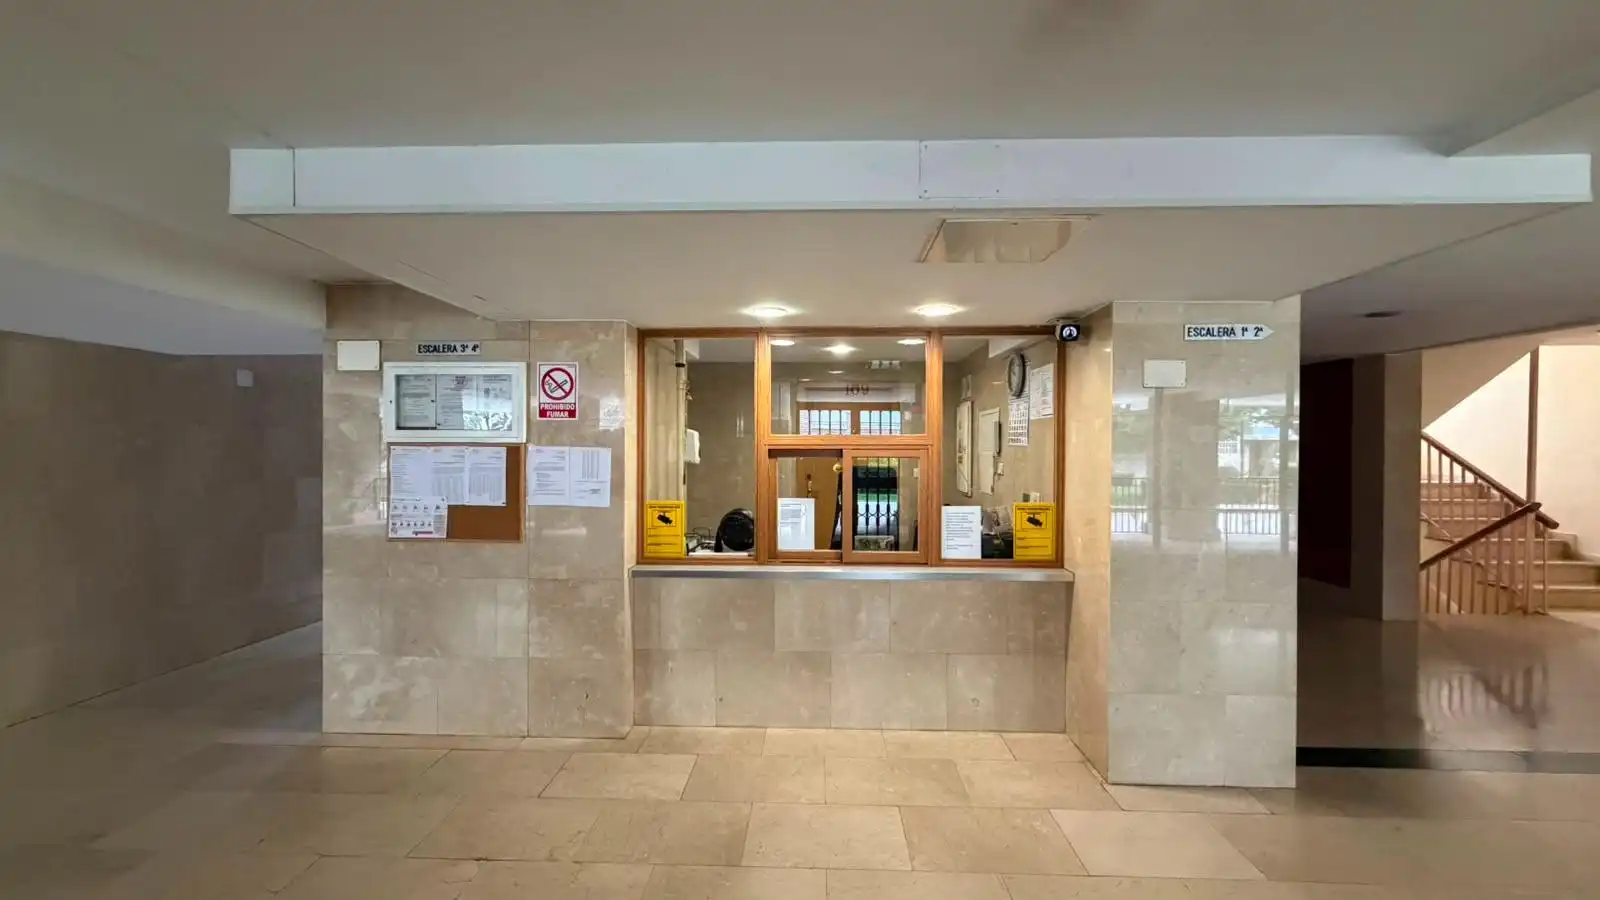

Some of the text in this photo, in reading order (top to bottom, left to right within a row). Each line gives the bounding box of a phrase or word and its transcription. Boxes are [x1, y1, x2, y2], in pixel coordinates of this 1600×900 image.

[1187, 326, 1236, 337] ESCALERA
[418, 344, 458, 353] ESCALERA
[546, 410, 569, 418] FUMAR
